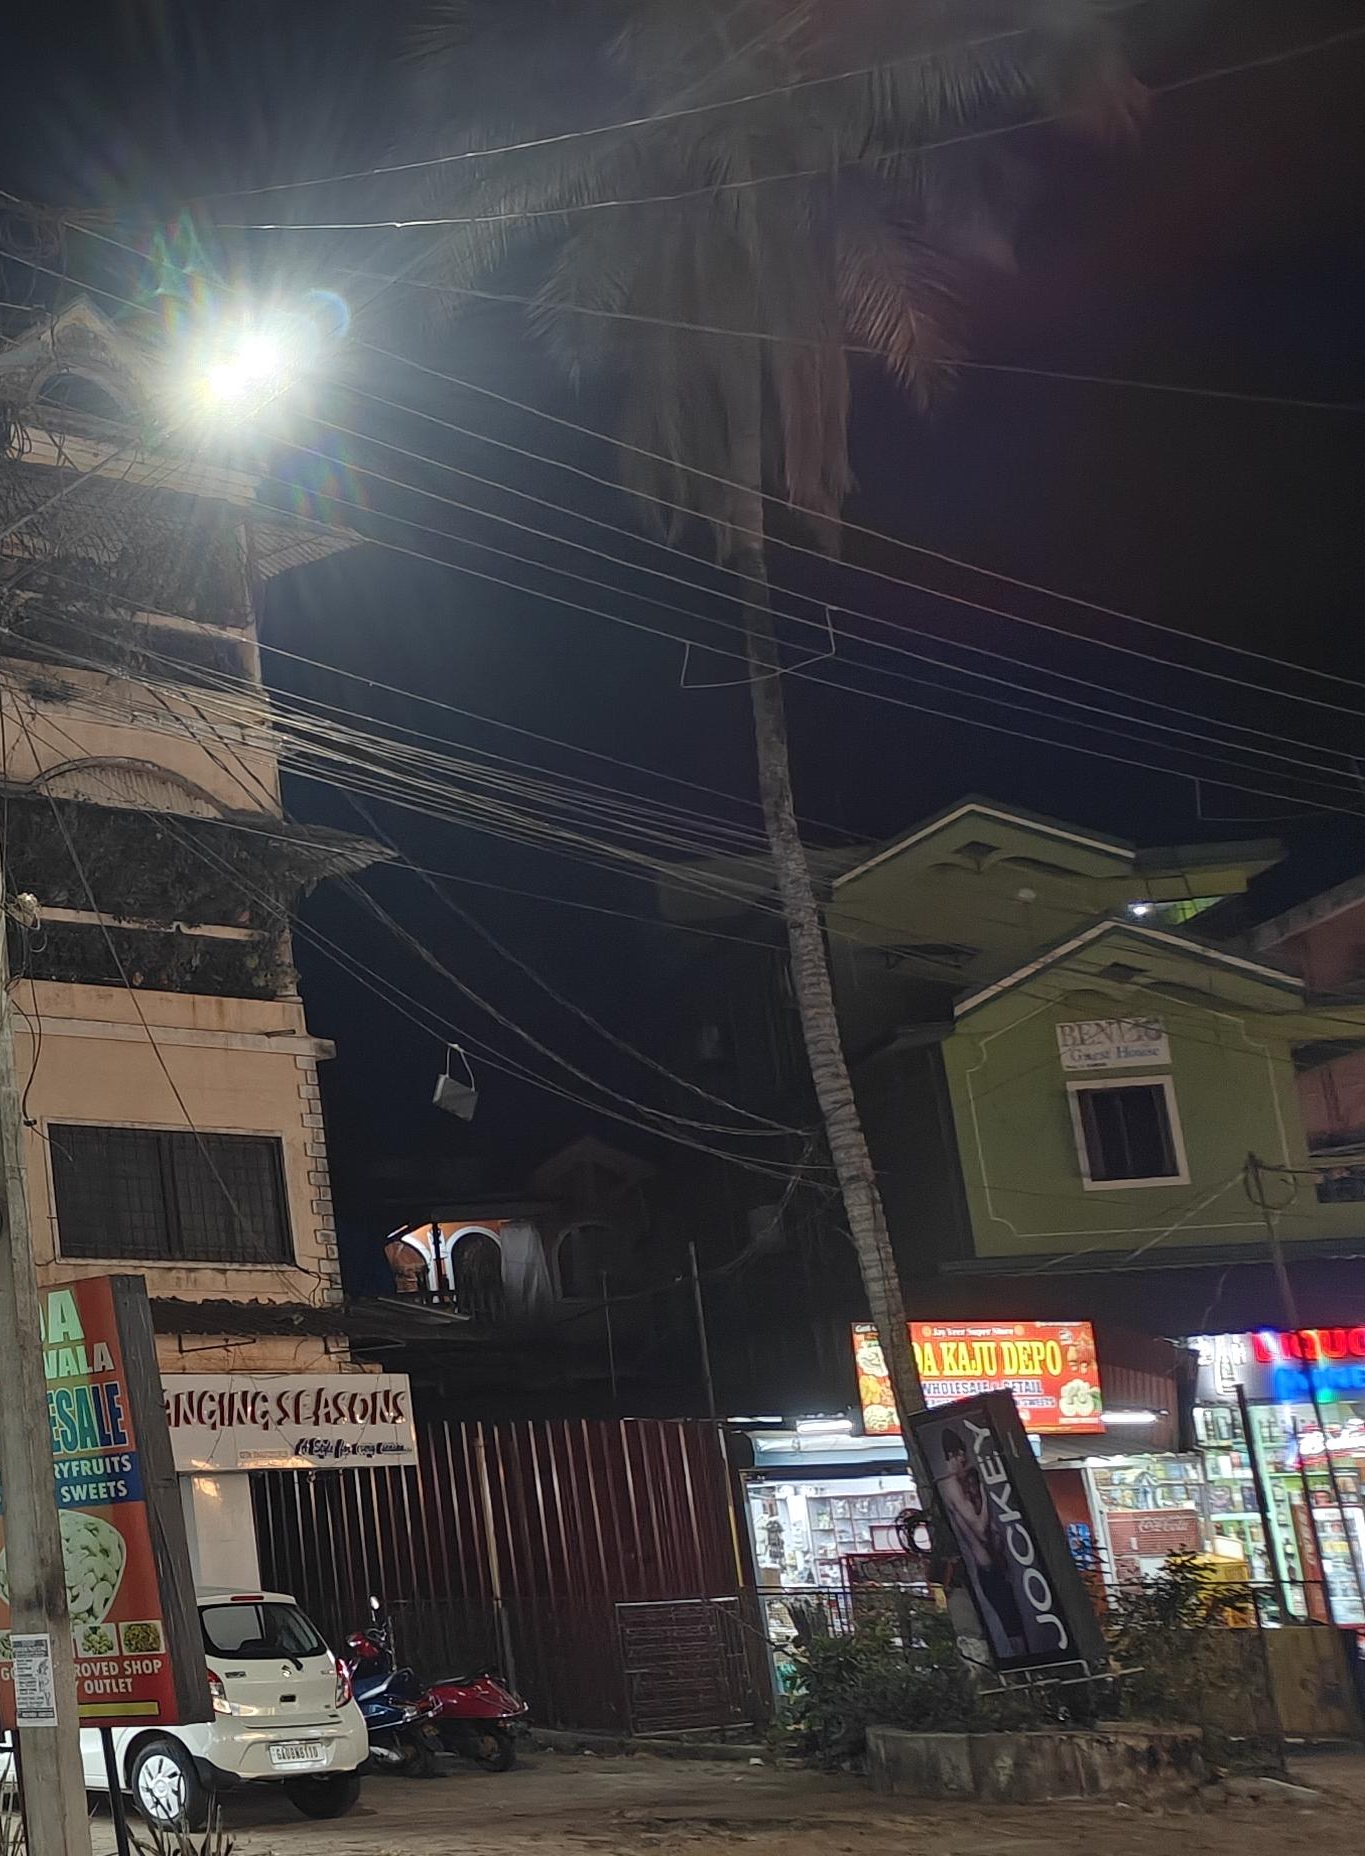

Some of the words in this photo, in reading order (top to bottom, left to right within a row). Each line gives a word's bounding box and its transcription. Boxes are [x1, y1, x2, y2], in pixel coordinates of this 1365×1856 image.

[940, 1341, 998, 1377] KAJU
[1000, 1340, 1062, 1377] DEPO
[276, 1388, 407, 1427] SEASONS
[54, 1454, 133, 1480] RYFRUITS
[60, 1480, 129, 1503] SWEETS
[963, 1419, 1068, 1650] JOCKEY
[123, 1659, 163, 1675] SHOP
[83, 1678, 133, 1694] OUTLET
